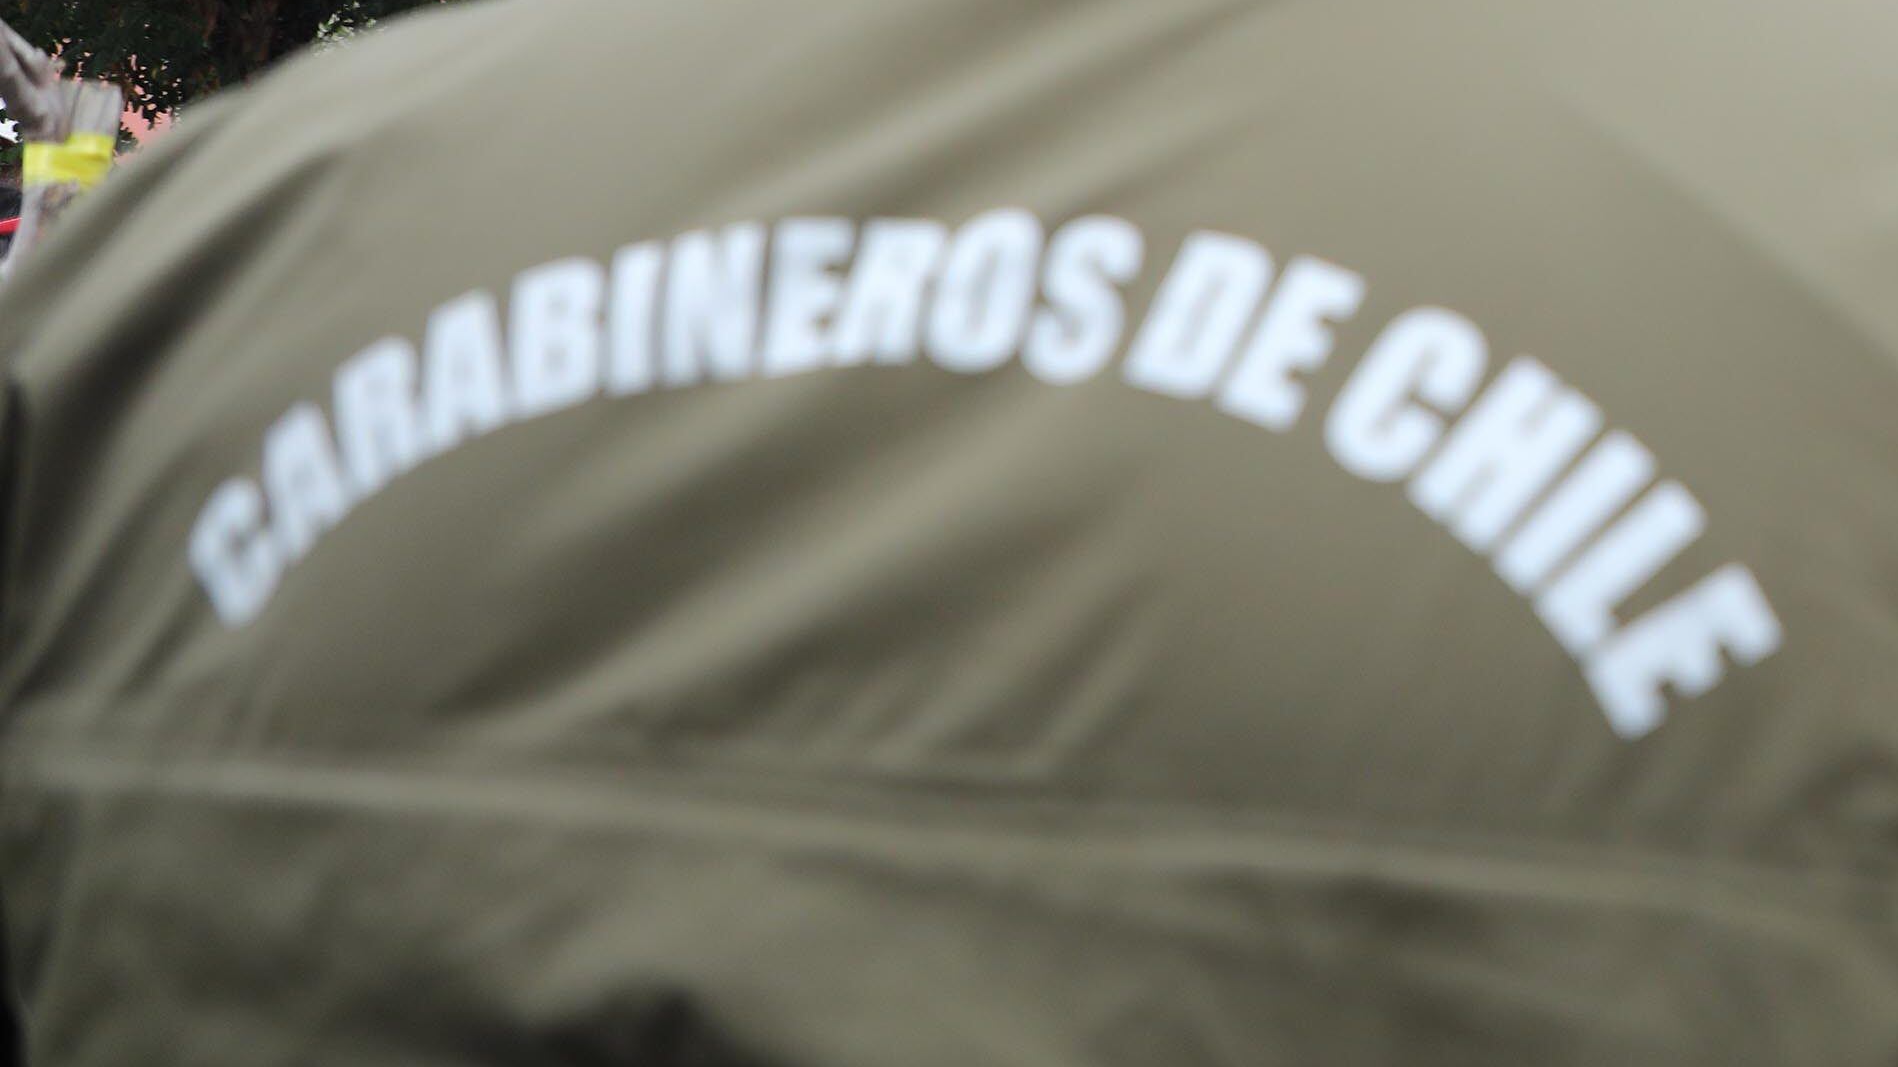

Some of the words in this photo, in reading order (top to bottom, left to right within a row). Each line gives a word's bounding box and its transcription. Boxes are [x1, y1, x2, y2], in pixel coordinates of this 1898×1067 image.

[188, 205, 1146, 627] CARABINEROS
[1122, 228, 1368, 431] DE
[1322, 305, 1782, 740] CHILE
